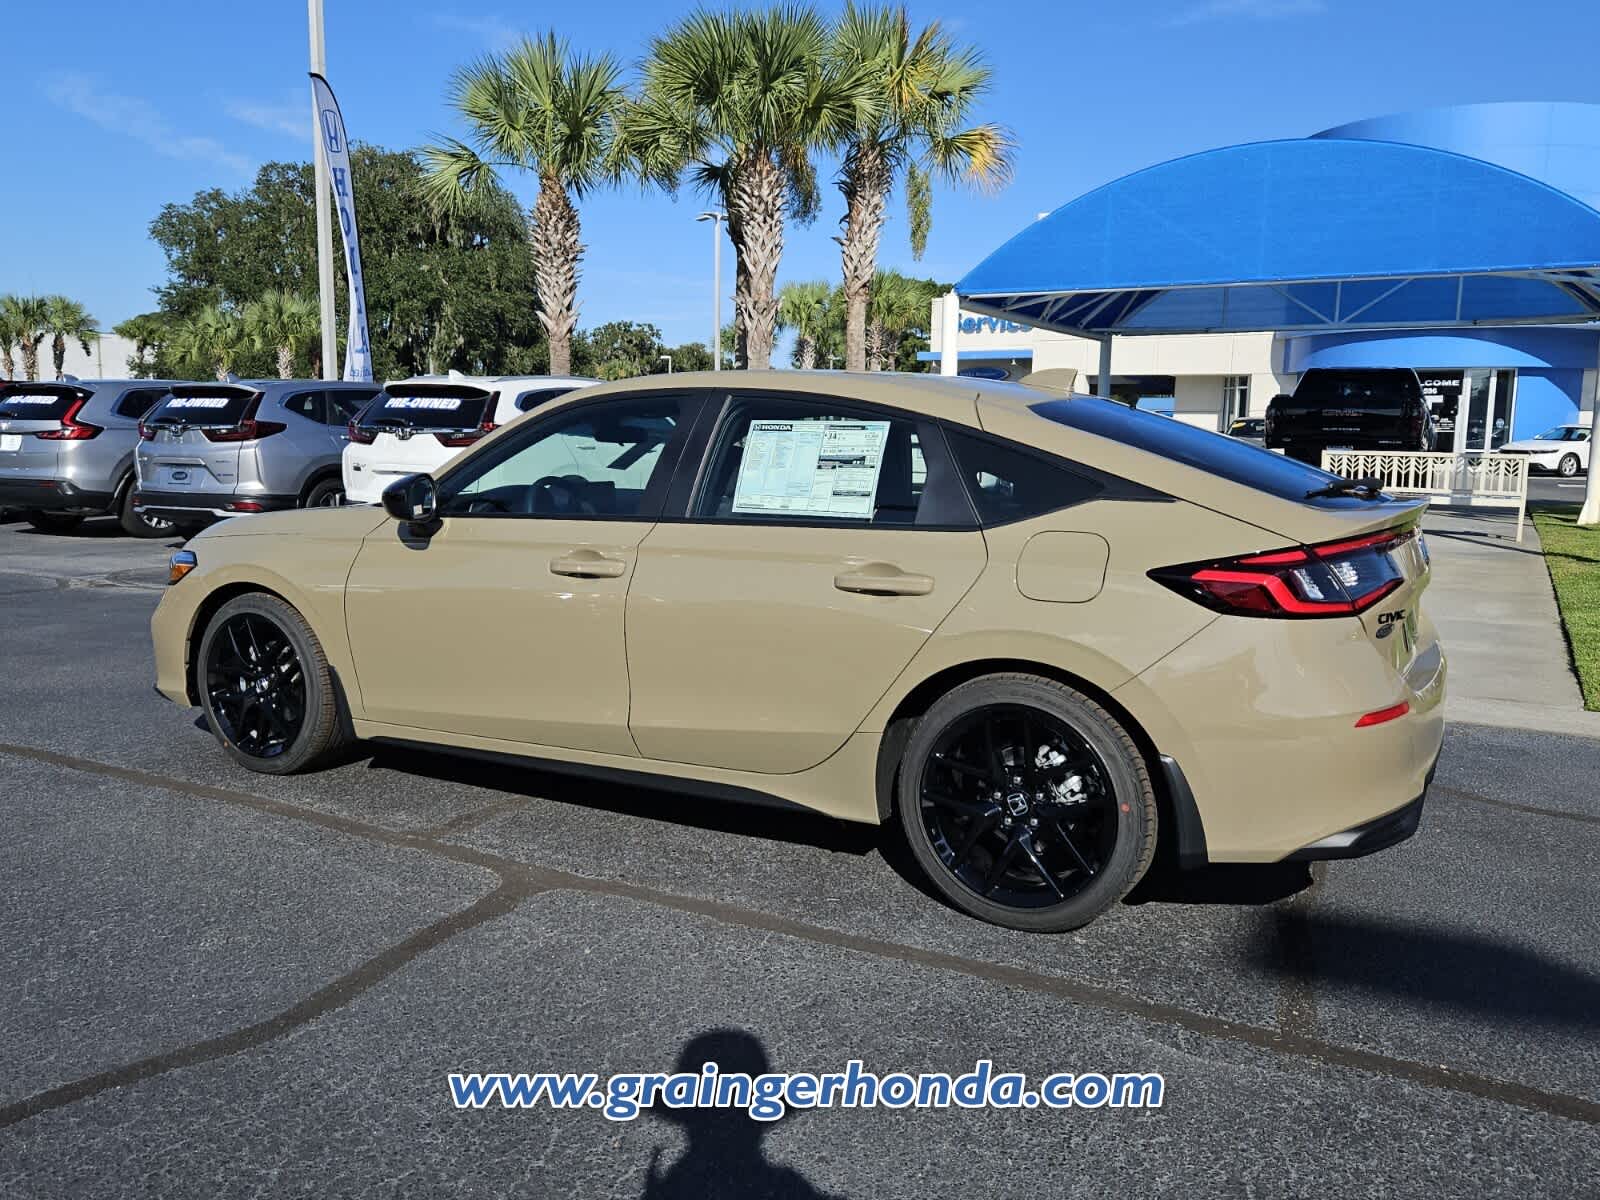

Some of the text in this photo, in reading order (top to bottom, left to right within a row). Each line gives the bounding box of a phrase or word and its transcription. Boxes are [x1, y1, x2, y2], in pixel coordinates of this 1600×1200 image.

[1420, 379, 1461, 387] COME
[384, 397, 462, 410] PRE-OWNED
[1377, 609, 1406, 624] CIVIC
